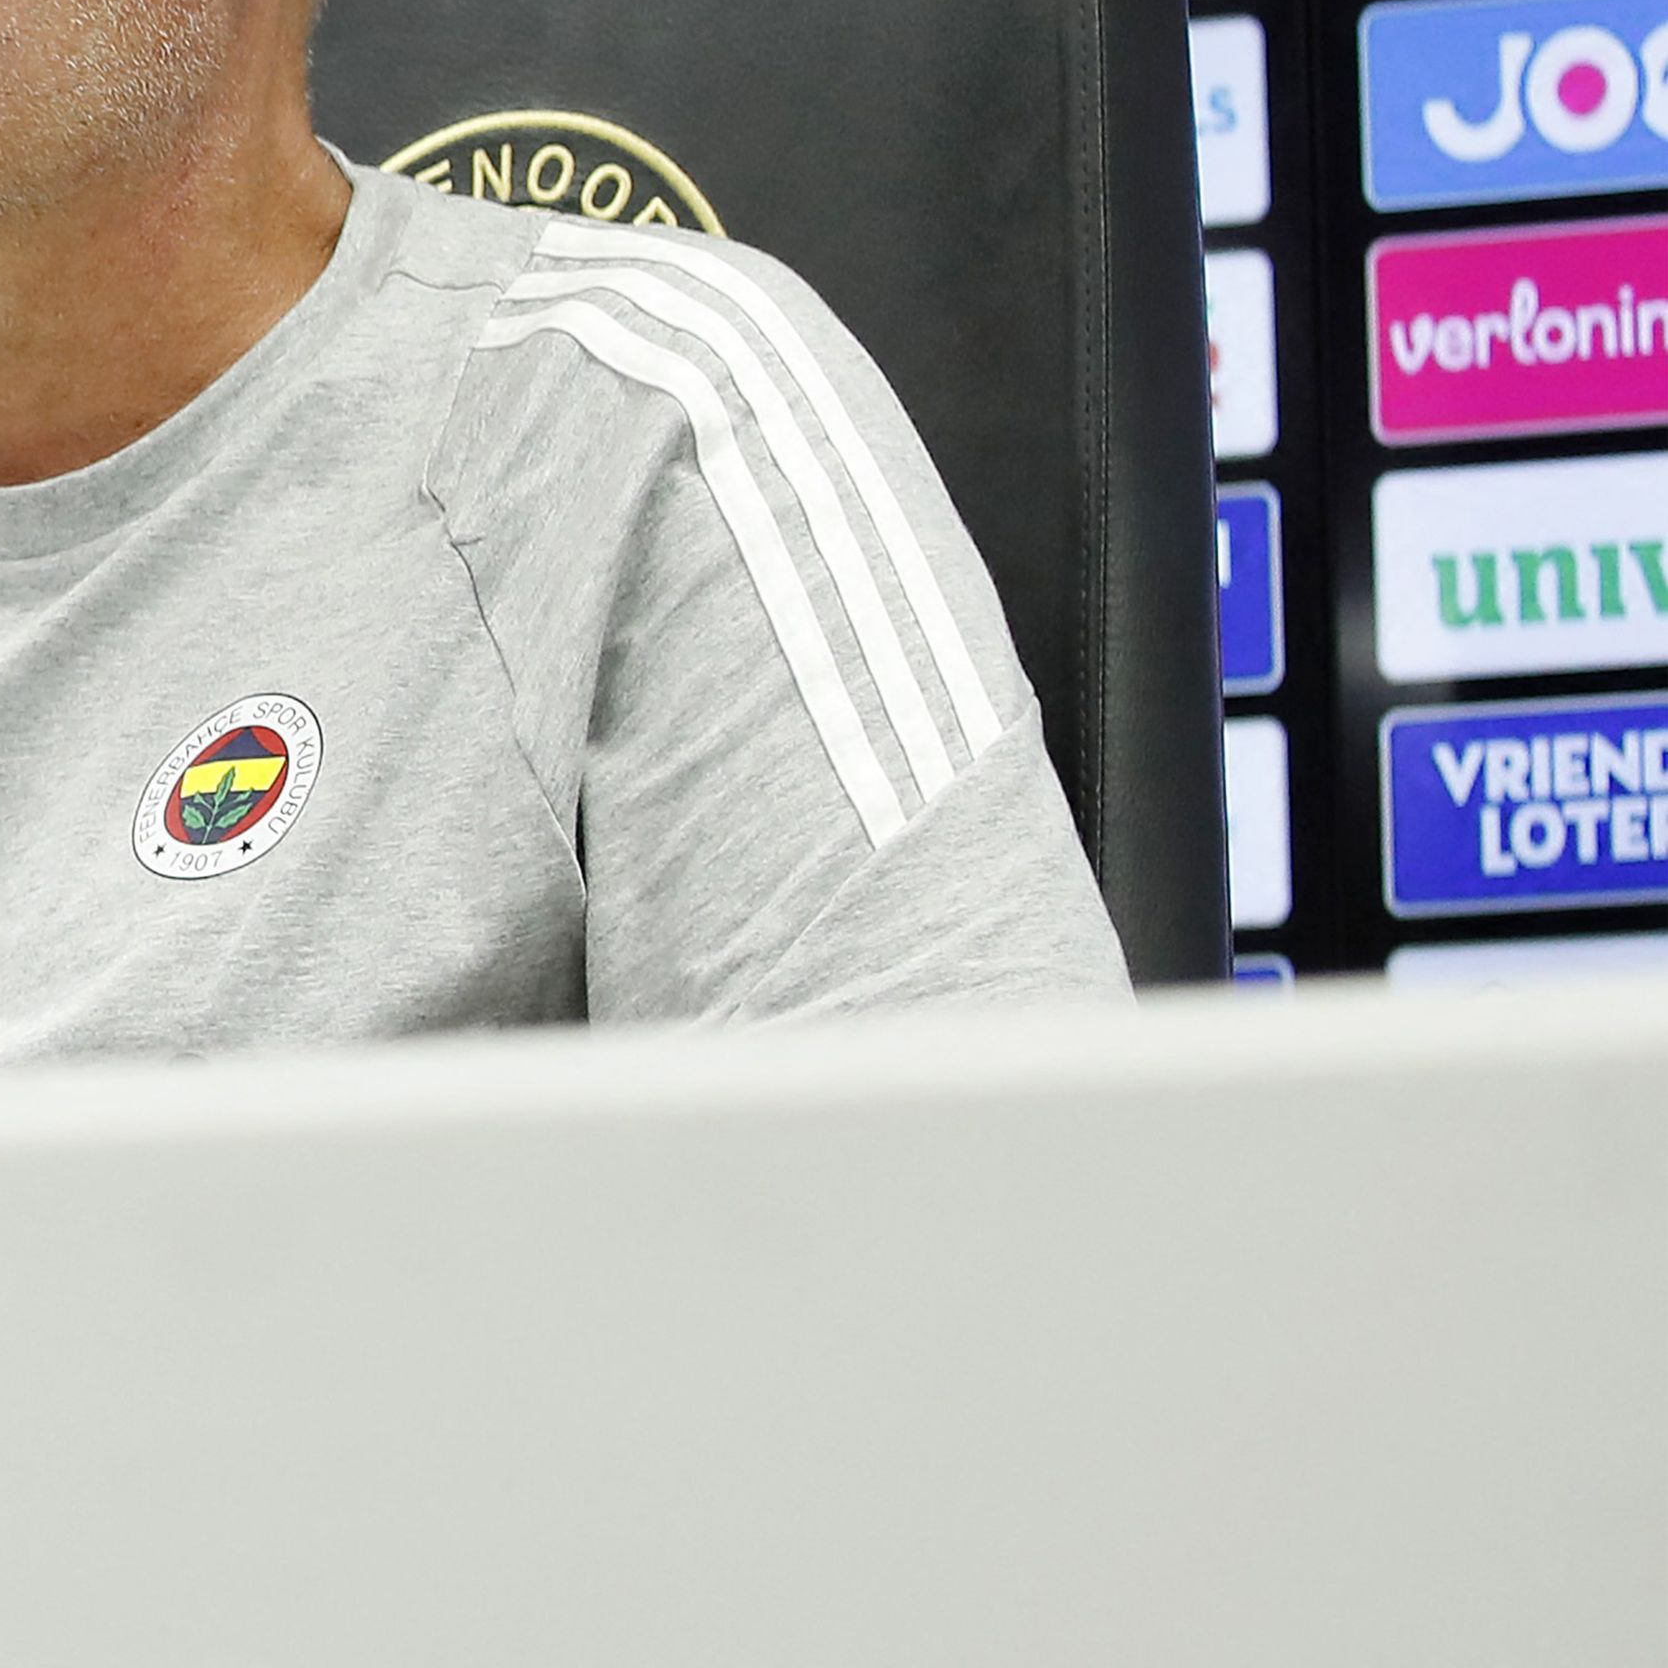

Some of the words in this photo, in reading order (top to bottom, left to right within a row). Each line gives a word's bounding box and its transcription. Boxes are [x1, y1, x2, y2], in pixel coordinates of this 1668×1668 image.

[1422, 22, 1668, 163] JO
[252, 701, 307, 737] SPOR
[169, 850, 224, 872] 1907
